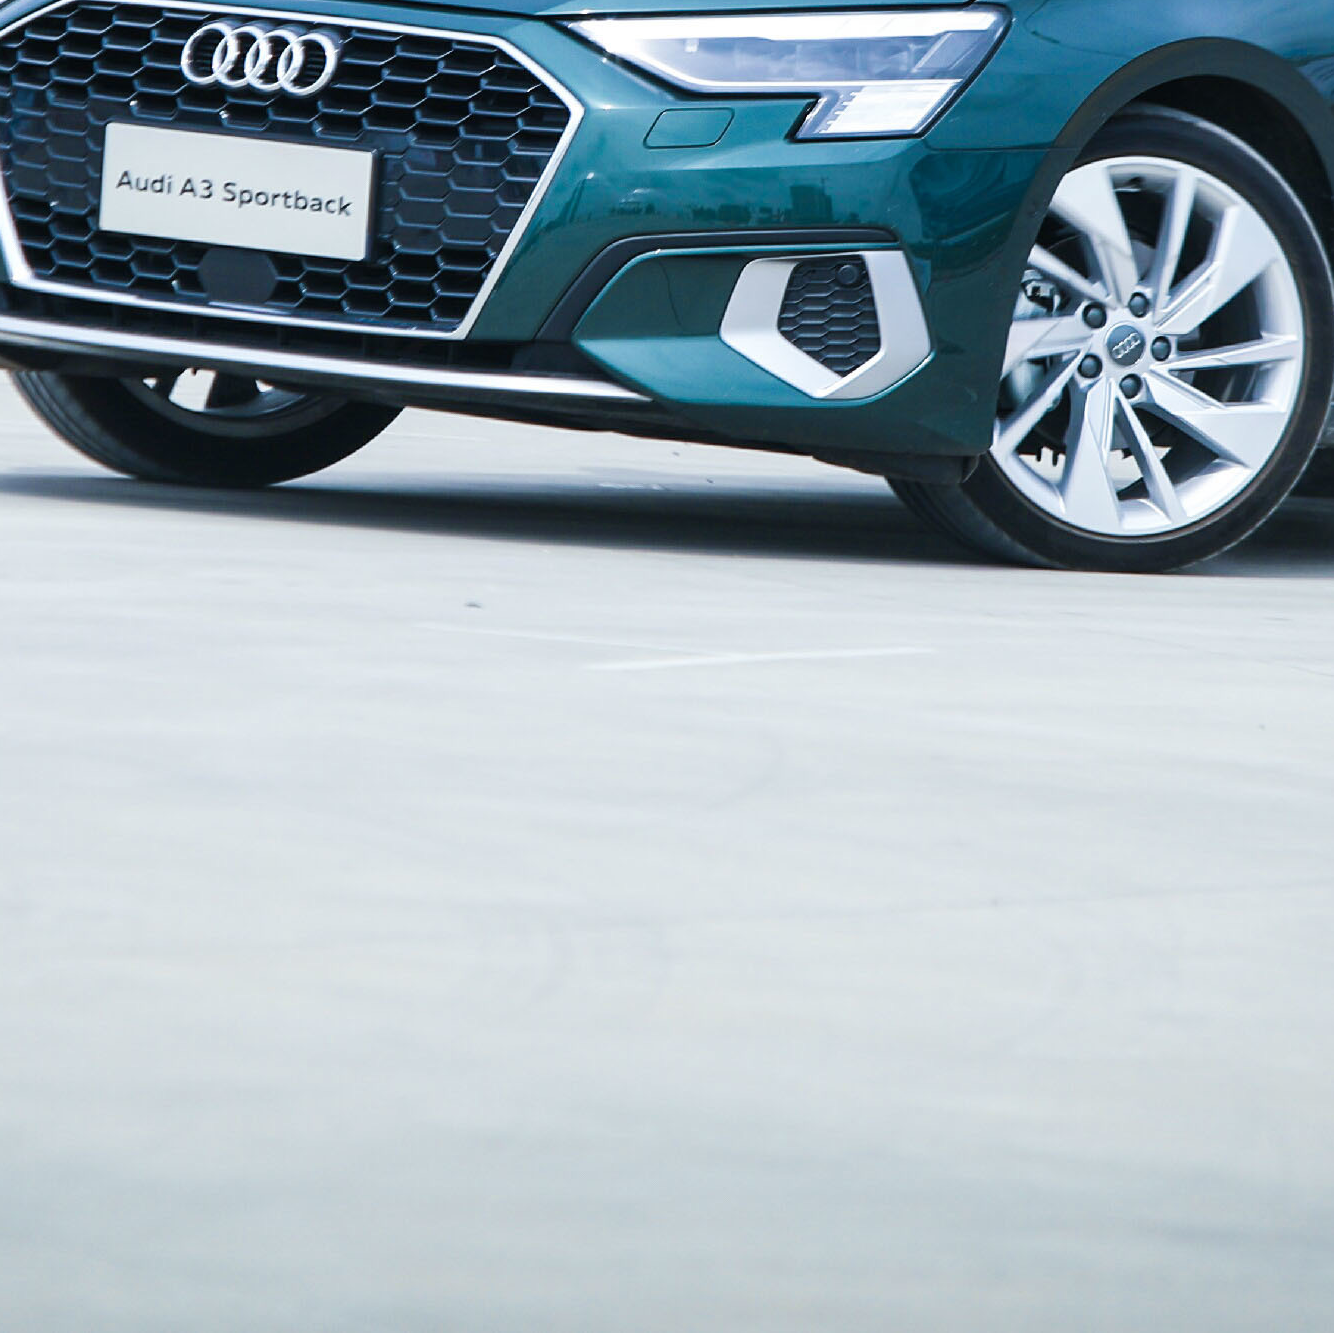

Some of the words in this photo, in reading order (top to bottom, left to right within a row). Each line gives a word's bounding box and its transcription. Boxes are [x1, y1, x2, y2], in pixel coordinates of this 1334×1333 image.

[116, 169, 174, 196] Audi
[178, 177, 215, 200] A3
[221, 181, 356, 217] Sportback
